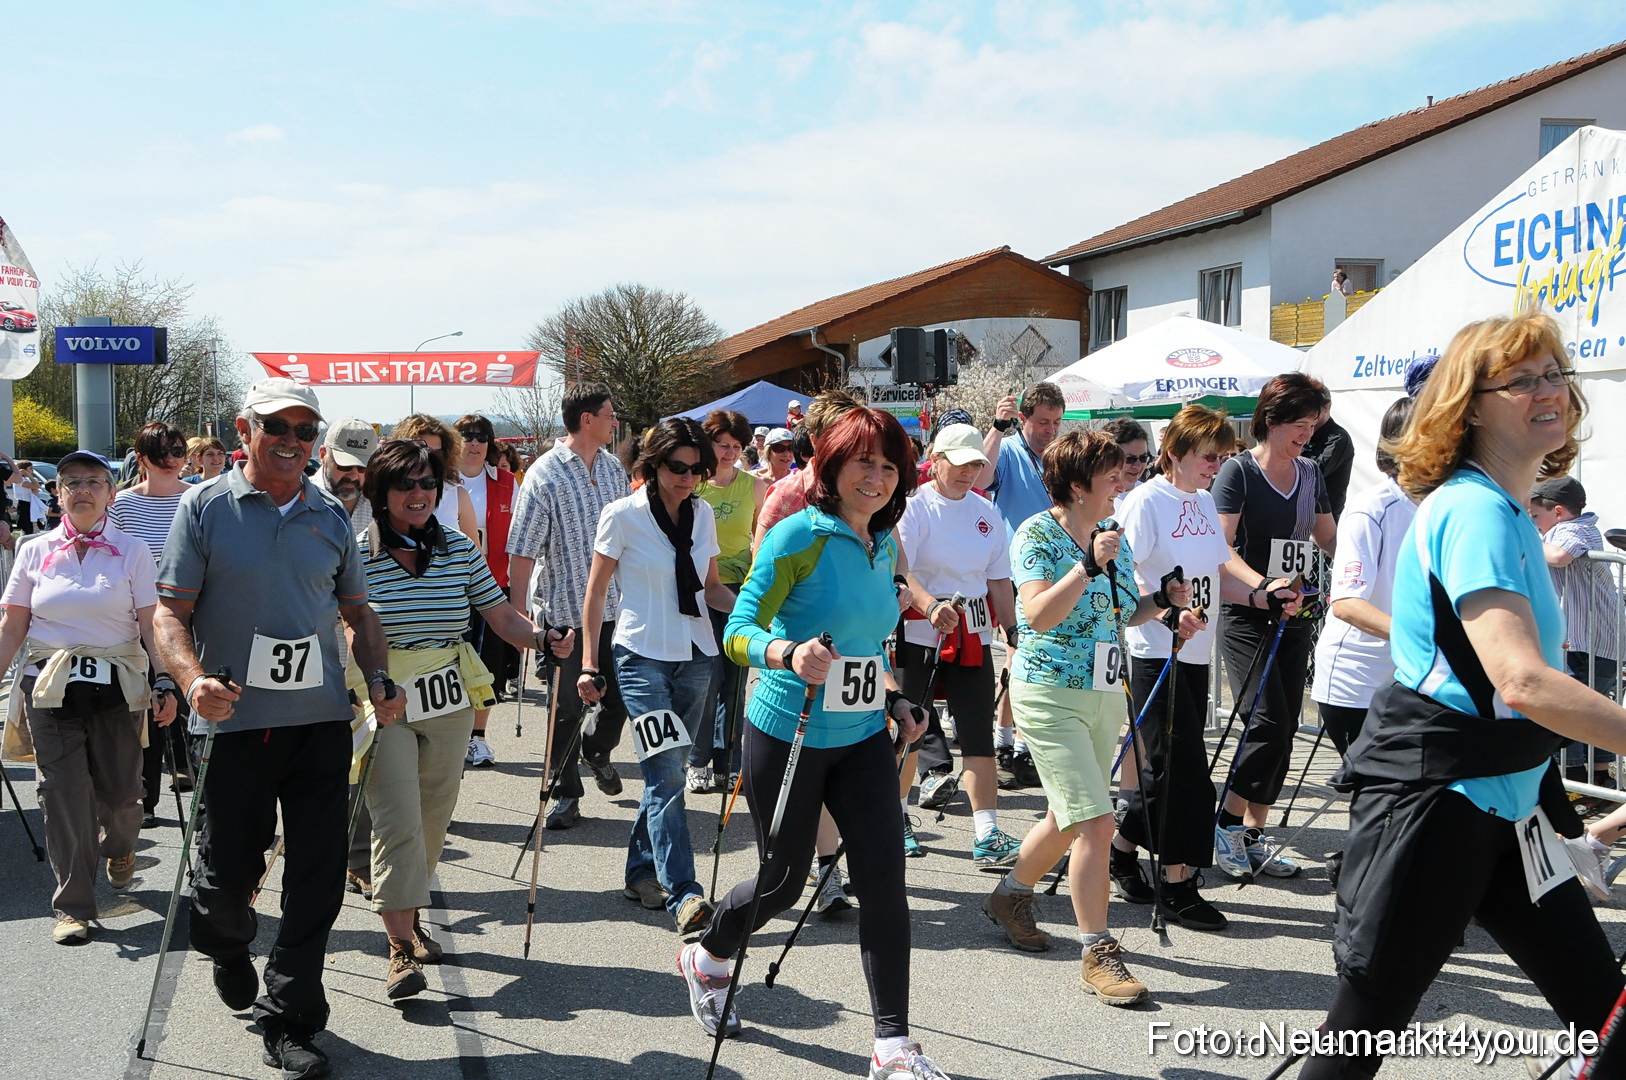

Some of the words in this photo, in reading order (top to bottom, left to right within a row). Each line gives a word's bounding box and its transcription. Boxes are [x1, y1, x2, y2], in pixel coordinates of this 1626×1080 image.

[1527, 156, 1626, 198] GETRÄNK
[6, 276, 24, 287] VOLVO
[64, 336, 141, 351] VOLVO
[1155, 376, 1240, 392] ERDINGER
[1281, 541, 1306, 573] 95
[1191, 575, 1211, 610] 93
[968, 597, 987, 628] 119
[270, 640, 311, 684] 37
[414, 669, 463, 713] 106
[841, 659, 877, 706] 58
[635, 712, 680, 753] 104
